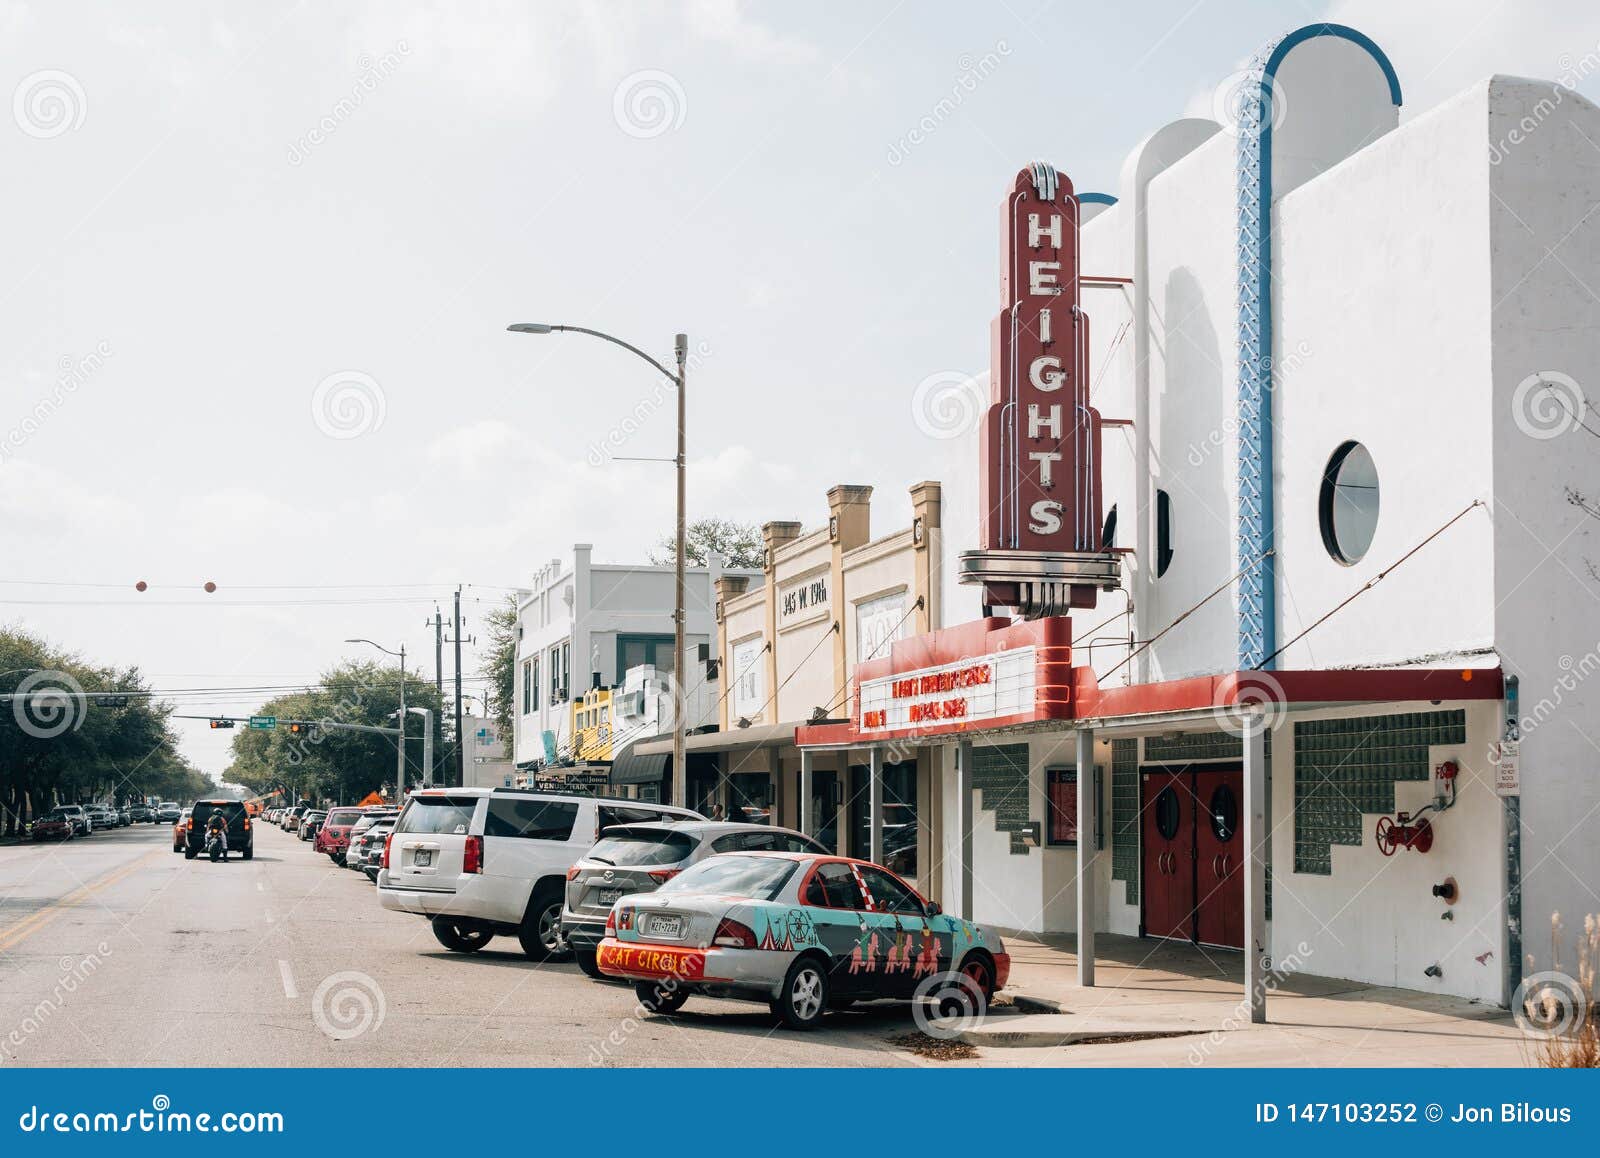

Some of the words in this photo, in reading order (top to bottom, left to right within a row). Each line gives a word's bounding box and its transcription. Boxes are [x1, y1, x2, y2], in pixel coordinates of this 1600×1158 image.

[1028, 213, 1068, 534] HEIGHTS
[783, 591, 796, 616] 345
[809, 578, 827, 606] 19th
[606, 947, 634, 966] CAT
